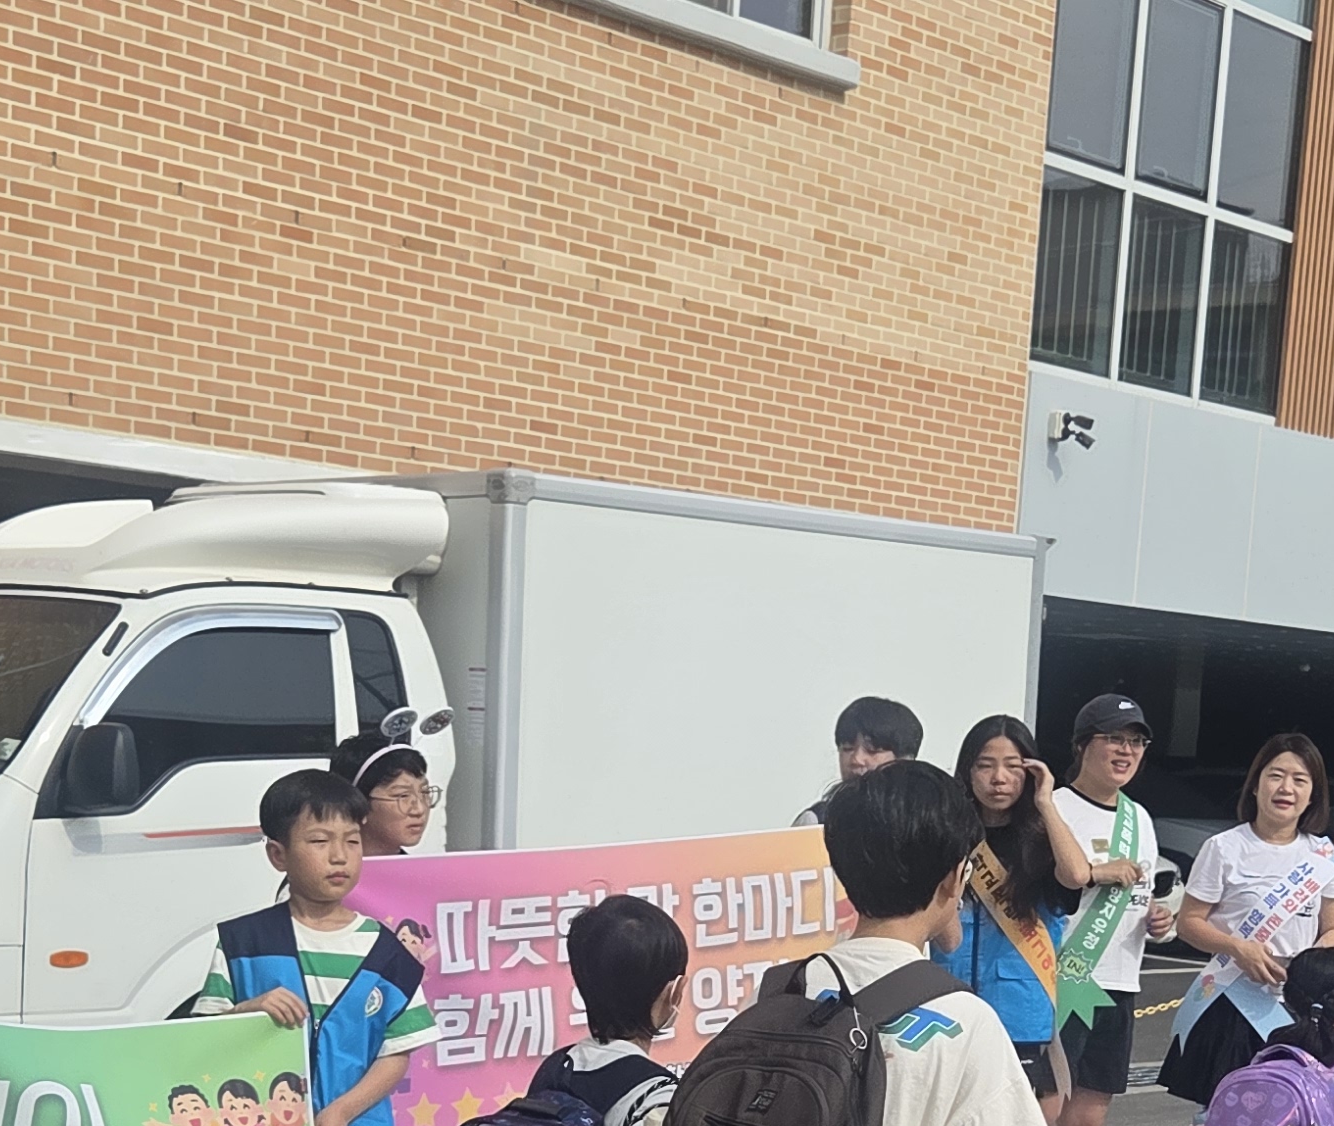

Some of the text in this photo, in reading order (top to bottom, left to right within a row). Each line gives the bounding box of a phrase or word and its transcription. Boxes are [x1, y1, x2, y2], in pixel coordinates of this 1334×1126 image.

[1287, 862, 1314, 886] 사랑
[692, 866, 835, 948] 한마디
[1263, 882, 1291, 910] 가득
[1282, 877, 1321, 914] 배려와
[1082, 886, 1123, 950] 양지우정
[1238, 908, 1266, 940] 행복
[1254, 912, 1284, 944] 존중
[1066, 957, 1085, 975] IN!
[433, 985, 556, 1067] 함께
